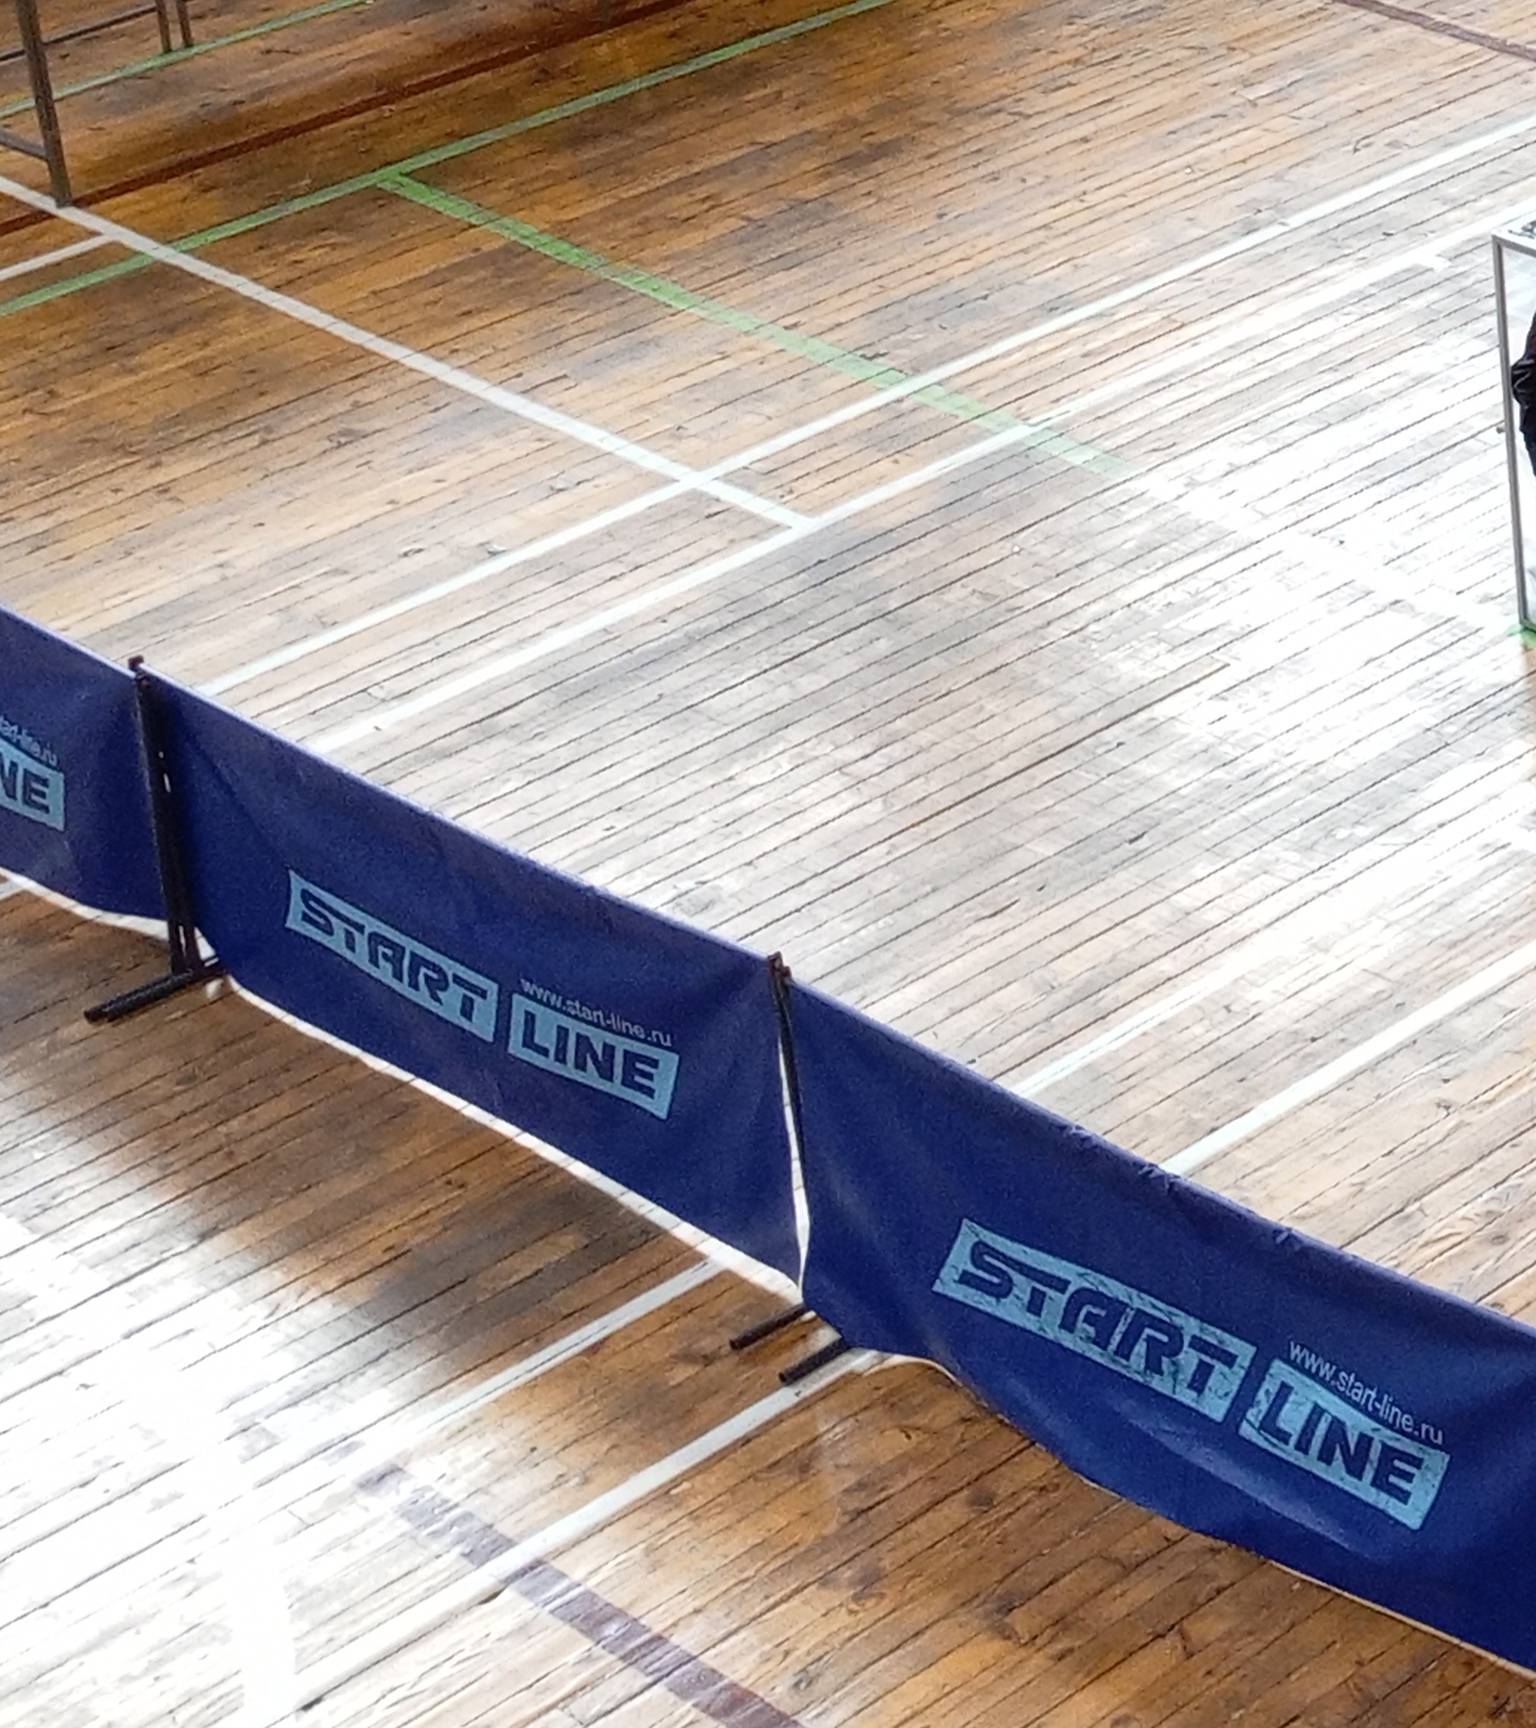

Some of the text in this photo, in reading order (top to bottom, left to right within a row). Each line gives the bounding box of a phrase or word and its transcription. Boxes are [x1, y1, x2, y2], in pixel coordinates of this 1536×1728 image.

[299, 887, 489, 1024] START
[520, 976, 673, 1048] www.start-line.ru
[521, 1009, 661, 1101] LINE
[956, 1238, 1241, 1396] START
[1256, 1378, 1428, 1507] LINE
[1288, 1337, 1444, 1446] www.start-line.ru
